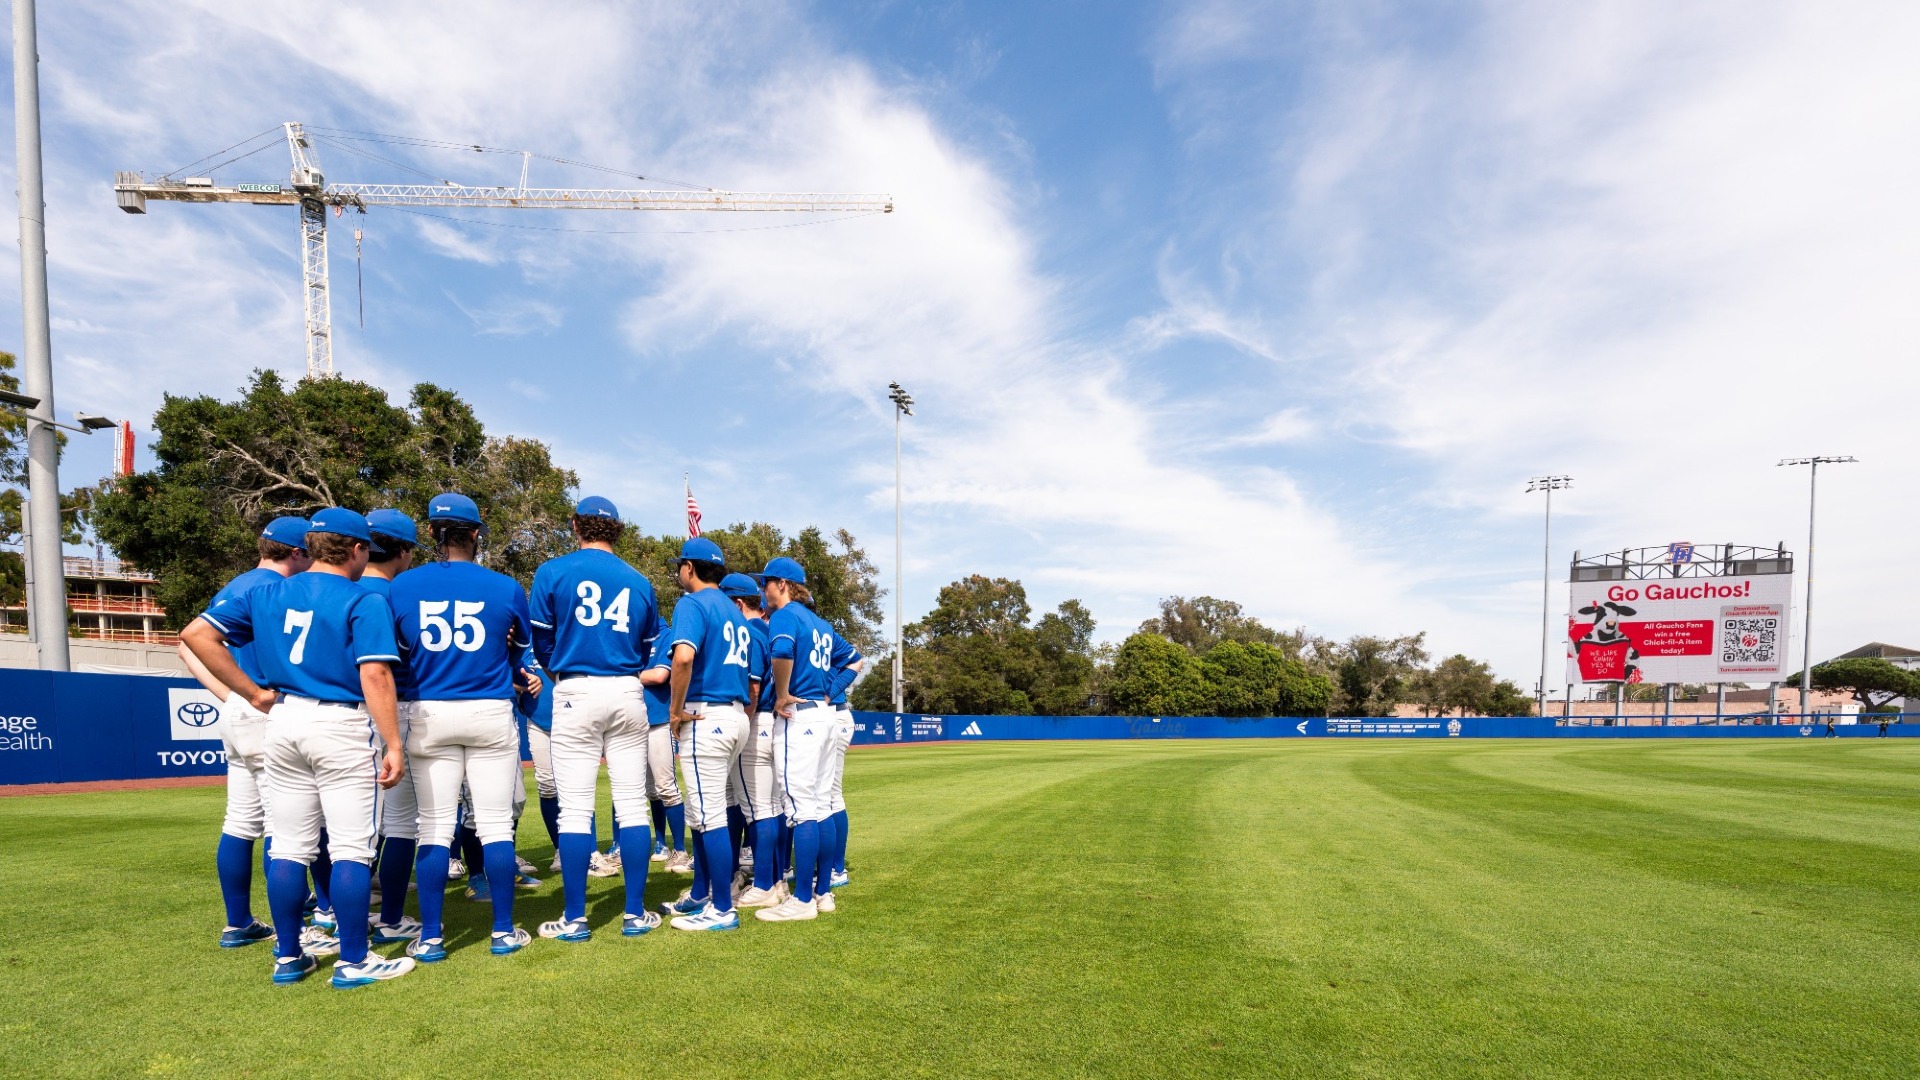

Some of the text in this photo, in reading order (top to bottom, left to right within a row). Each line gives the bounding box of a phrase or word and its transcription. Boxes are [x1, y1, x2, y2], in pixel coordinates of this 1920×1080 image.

[574, 580, 630, 634] 34
[1608, 581, 1750, 601] Go Gauchos!
[282, 610, 314, 665] 7
[419, 600, 486, 652] 55
[723, 620, 751, 668] 28
[809, 628, 833, 672] 33
